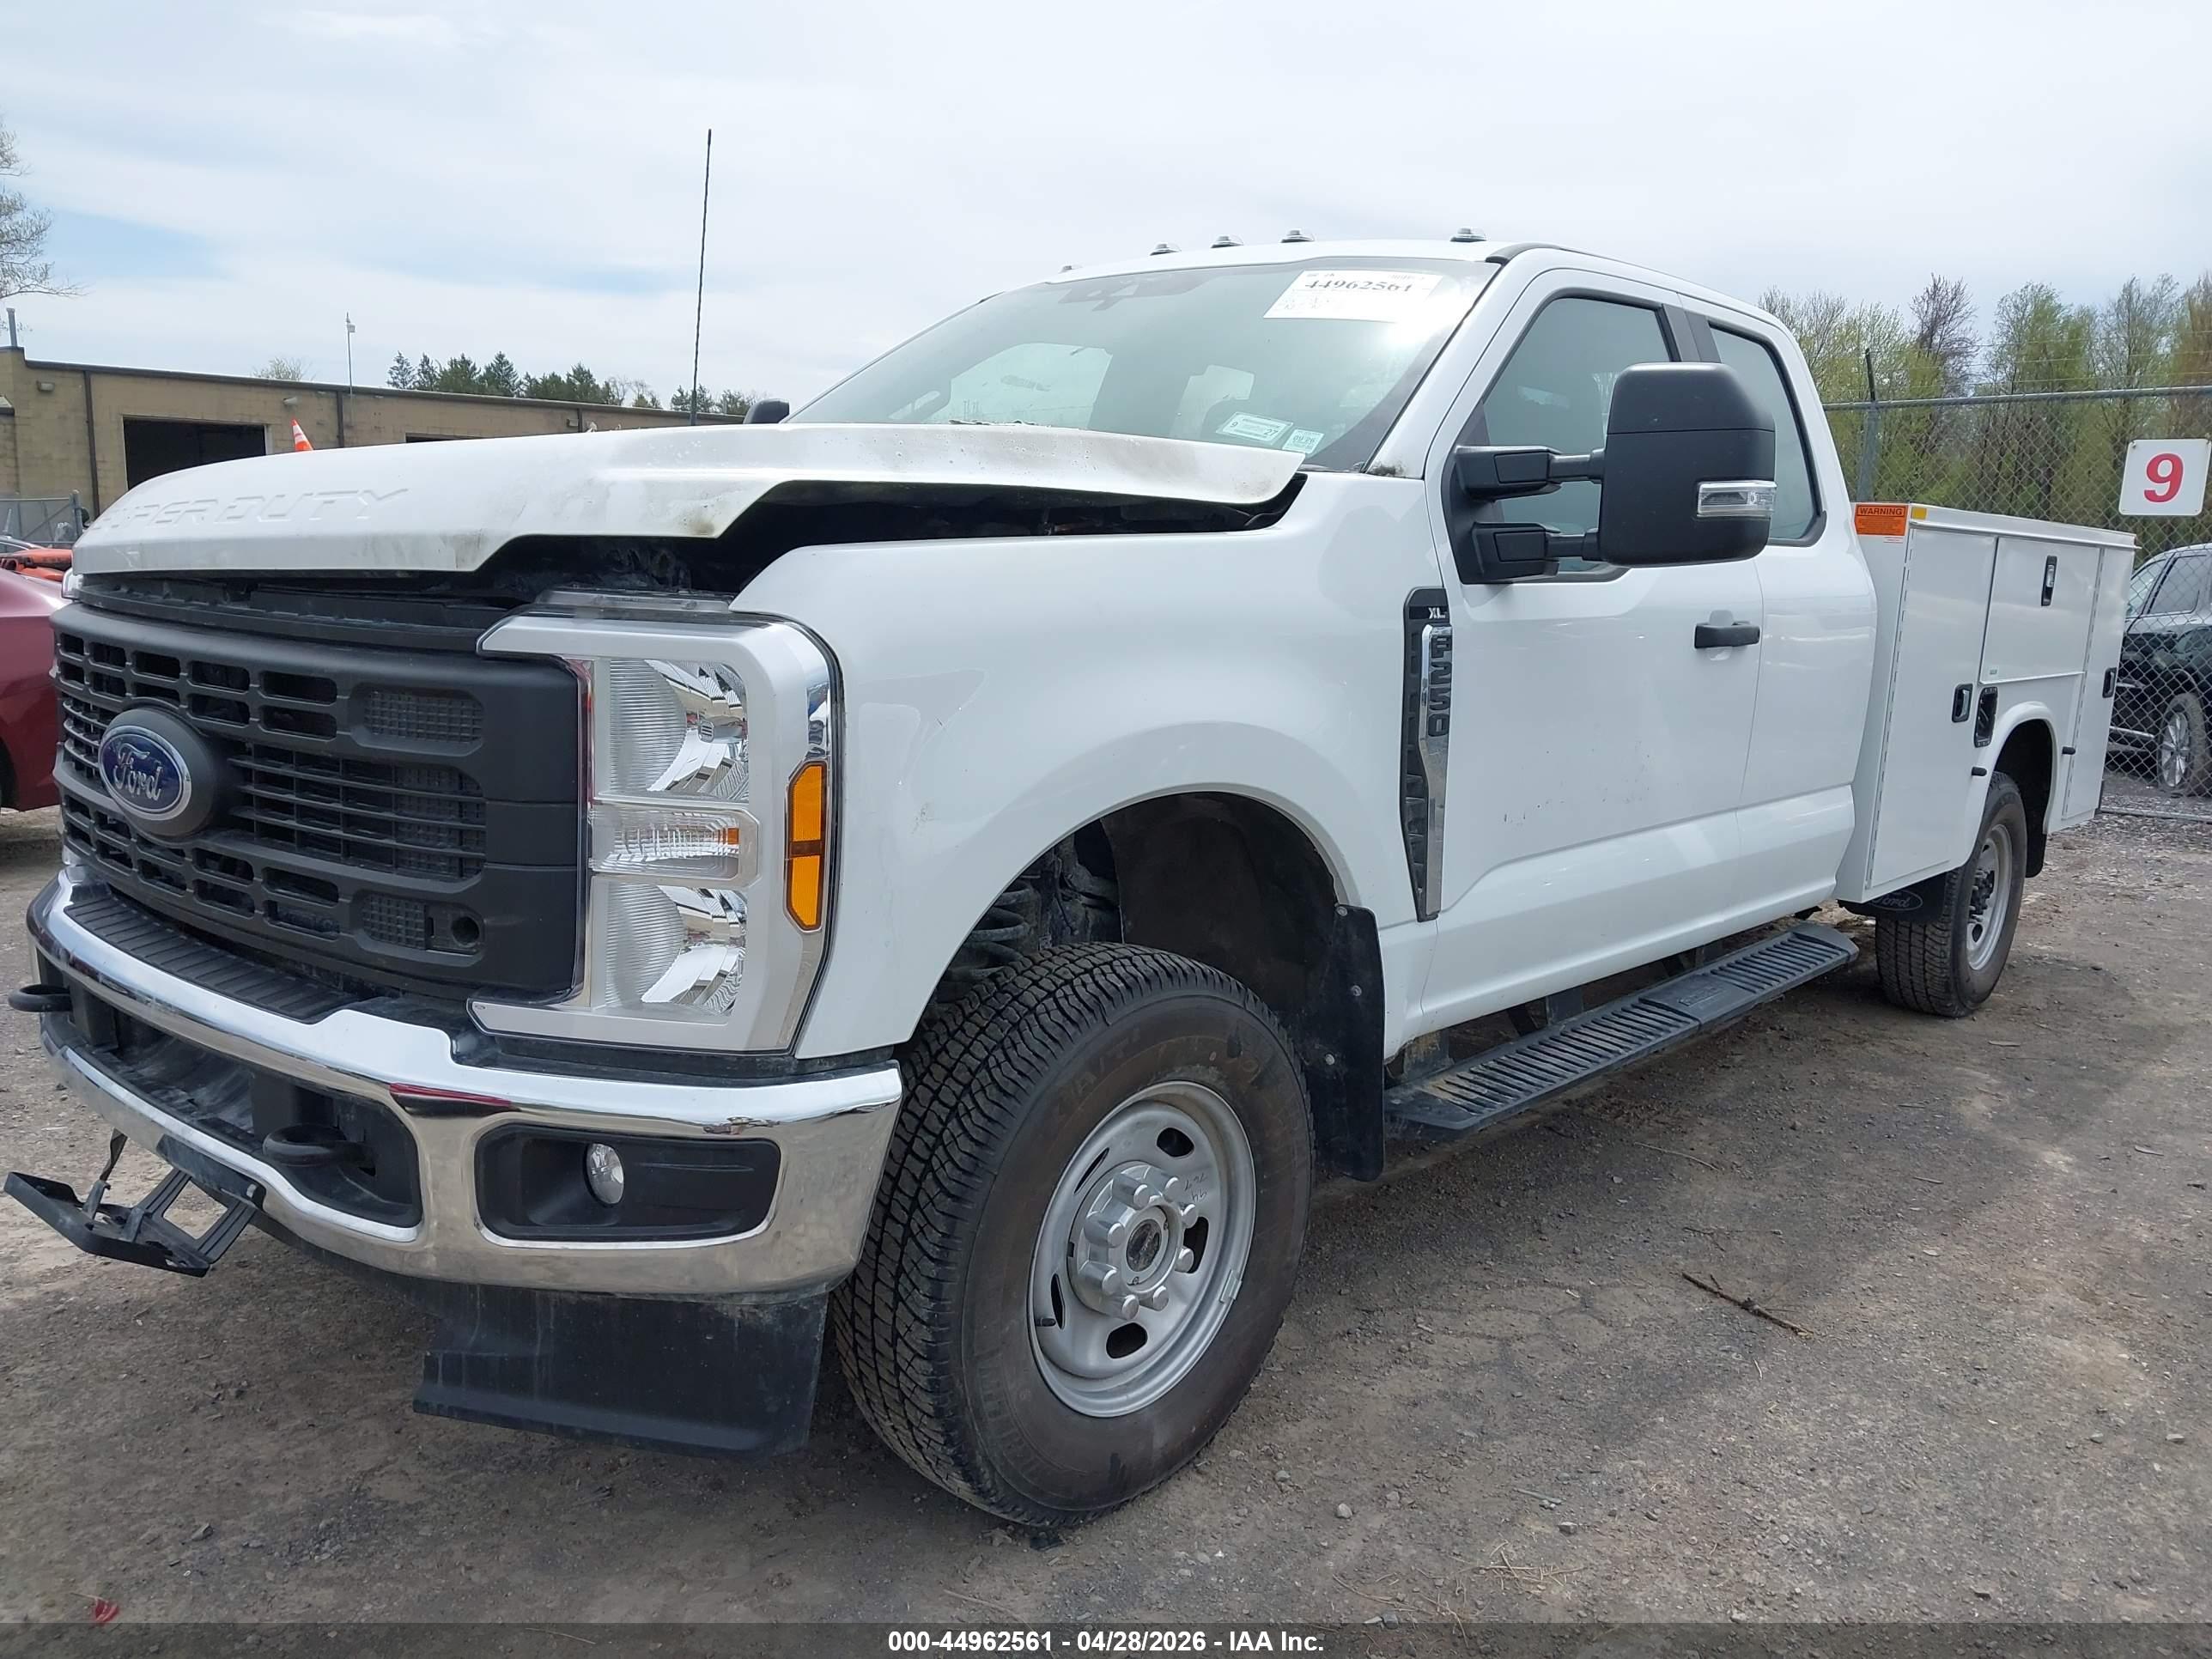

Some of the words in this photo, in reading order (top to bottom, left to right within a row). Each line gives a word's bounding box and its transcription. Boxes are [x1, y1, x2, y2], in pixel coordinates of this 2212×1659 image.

[1304, 280, 1413, 292] 44962561
[2143, 453, 2184, 503] 9
[213, 488, 410, 523] DUTY
[1428, 607, 1447, 619] XL
[112, 742, 163, 801] Ford
